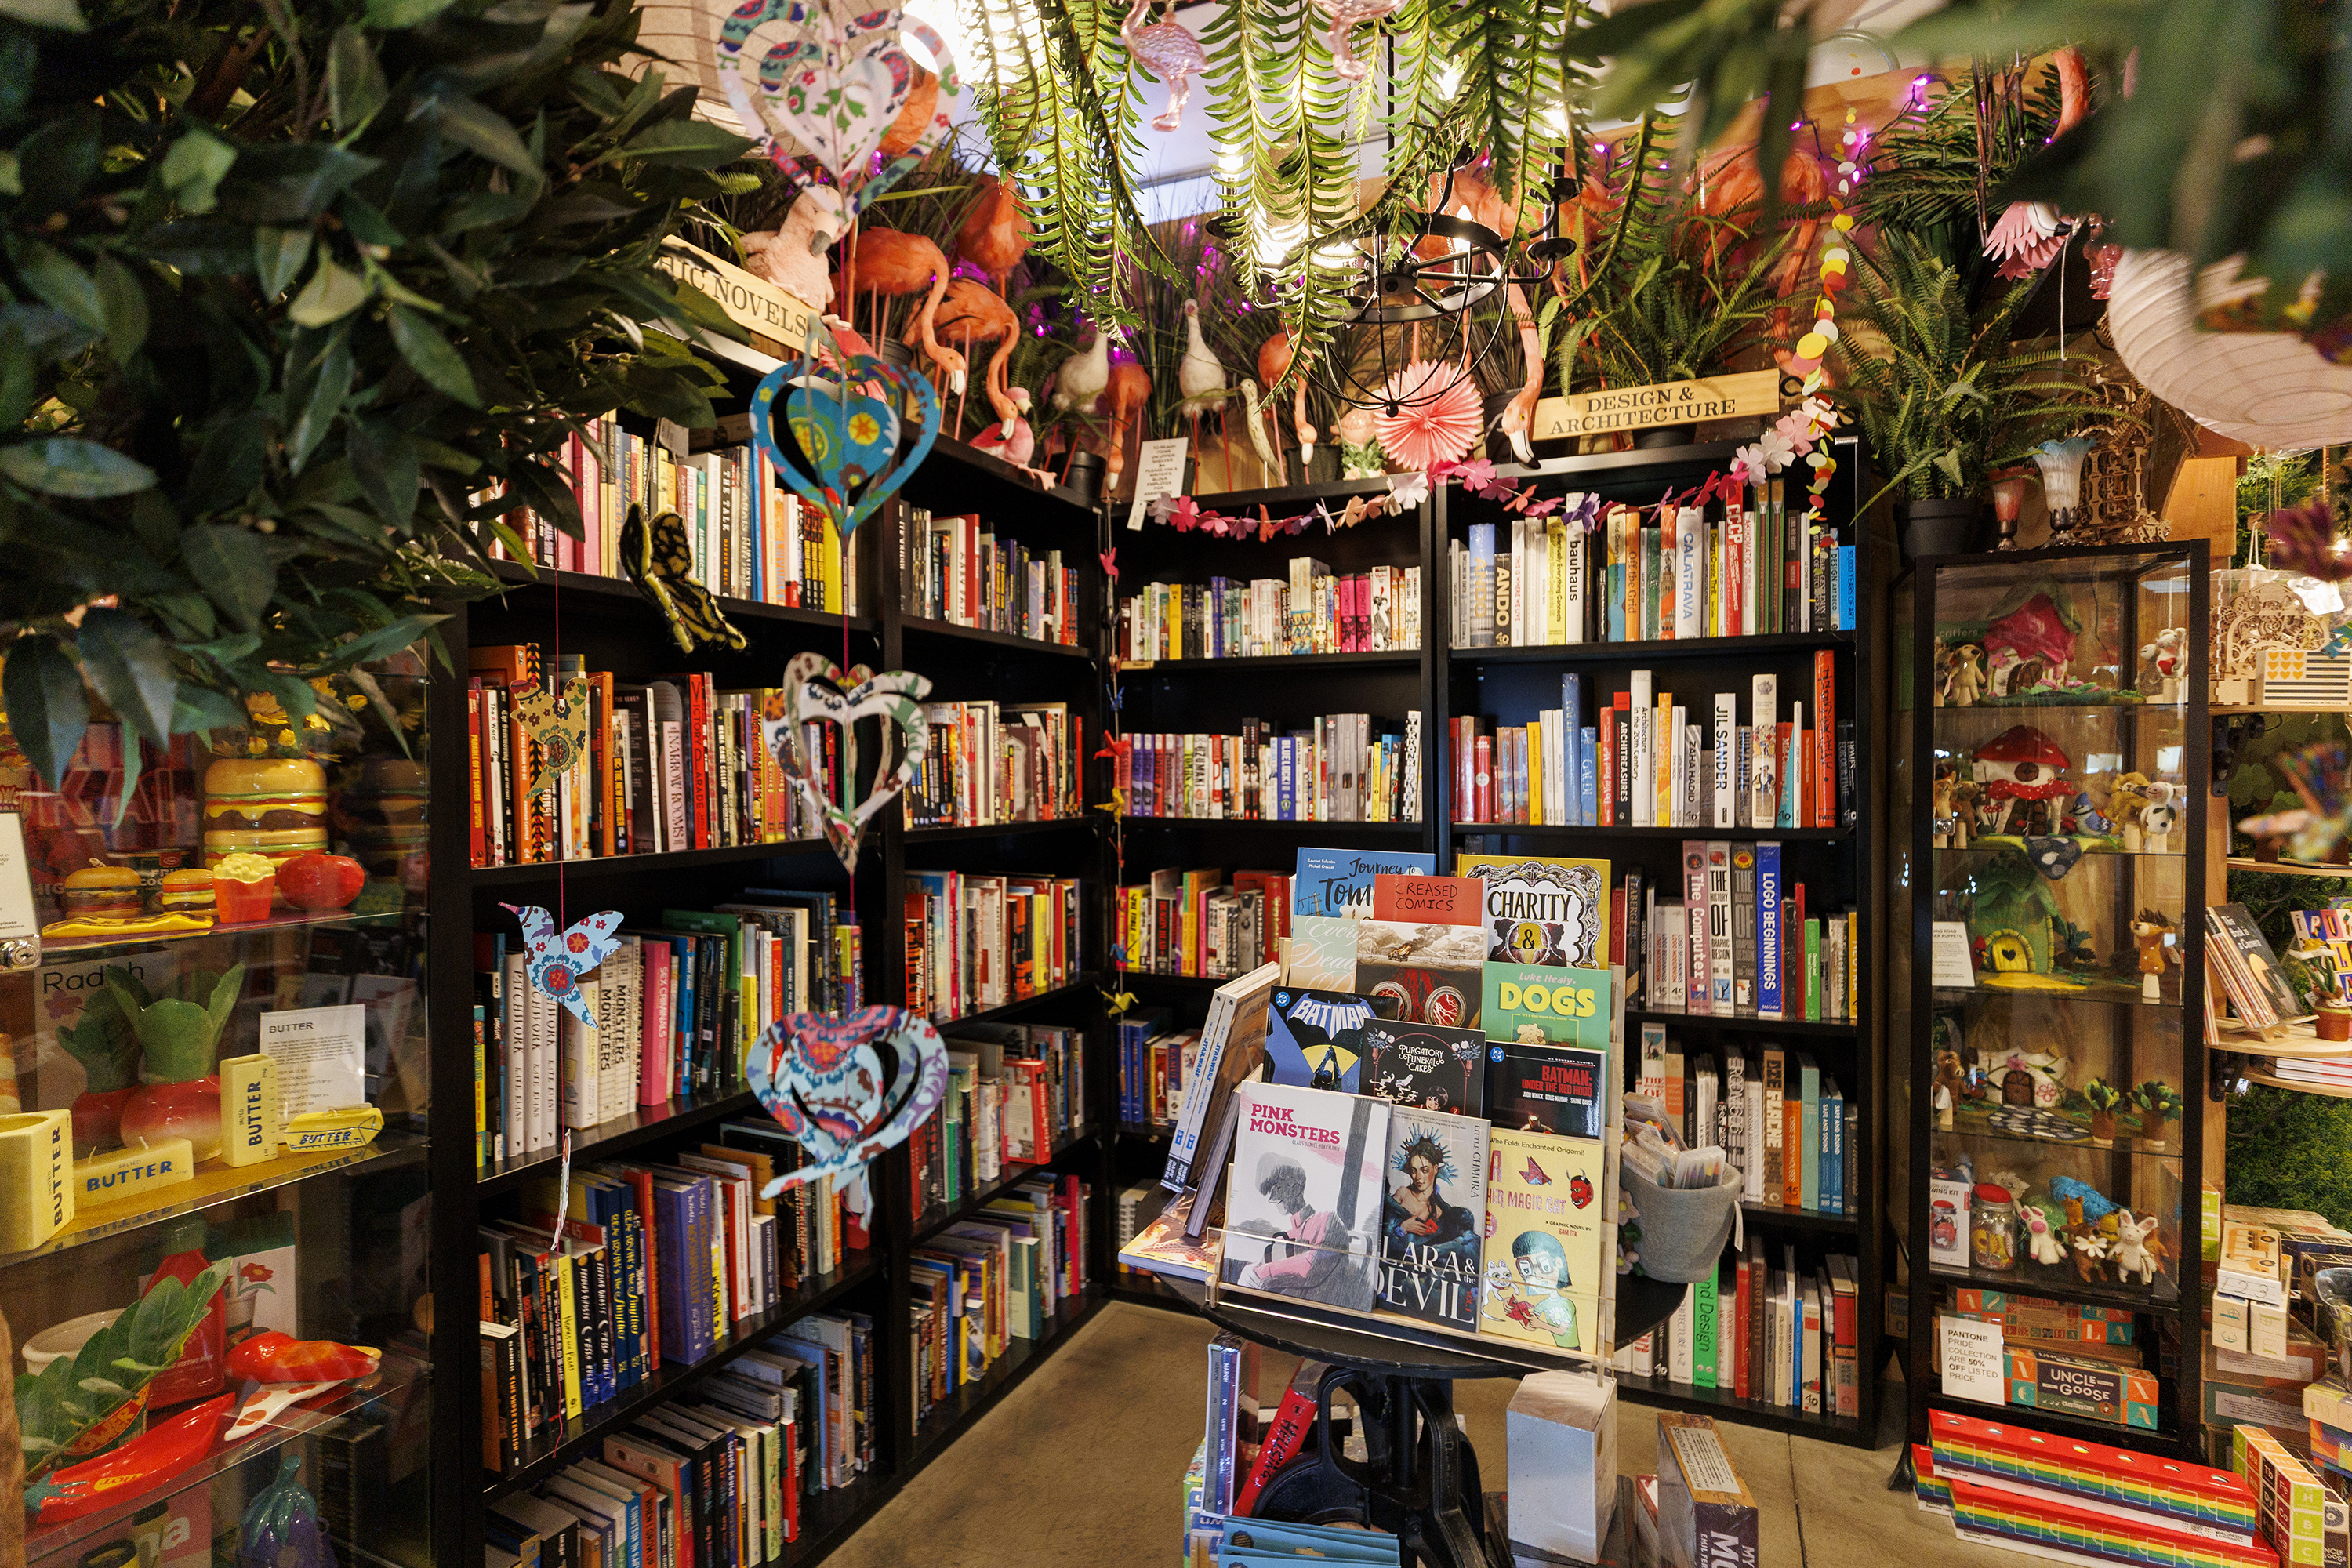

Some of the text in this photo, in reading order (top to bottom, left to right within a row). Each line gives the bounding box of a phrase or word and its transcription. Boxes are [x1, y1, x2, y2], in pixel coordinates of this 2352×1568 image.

[713, 274, 807, 338] NOVELS
[1587, 386, 1694, 412] DESIGN &
[1549, 399, 1736, 435] ARCHITECTURE
[1726, 504, 1743, 543] CCCP
[1570, 540, 1581, 601] bauhaus
[1628, 551, 1638, 613] Off the Grid
[1682, 533, 1694, 619] CALATRAVA
[1475, 557, 1487, 618] ANDO
[1496, 567, 1510, 626] ANDO
[1848, 593, 1854, 603] OF
[1515, 599, 1521, 608] WE
[470, 735, 480, 760] PARABLE
[1715, 706, 1728, 789] JIL SANDER
[1195, 746, 1206, 787] UZUMAKI
[1632, 749, 1640, 780] Century
[1738, 731, 1750, 791] HUMANIZE
[1780, 737, 1789, 786] Mid-Century
[668, 735, 684, 837] NARROW ROOMS
[1688, 771, 1697, 803] HADID
[1349, 856, 1416, 878] Journey to
[1319, 877, 1374, 912] Tom
[1396, 883, 1457, 898] CREASED
[1396, 899, 1454, 912] COMICS
[1487, 890, 1573, 922] CHARITY
[1690, 873, 1706, 979] The Computer
[1762, 873, 1776, 990] LOGO BEGINNINGS
[1522, 929, 1534, 950] &
[1519, 972, 1573, 986] Luke Healy
[512, 970, 524, 1054] PATCHWORK
[658, 967, 667, 1038] SEX CRIMINALS
[1500, 982, 1596, 1018] DOGS
[269, 1022, 314, 1033] BUTTER
[600, 989, 612, 1071] MONSTERS
[615, 985, 626, 1064] MONSTERS
[1294, 1000, 1371, 1040] BATMAN
[1207, 1042, 1221, 1082] STAR WARS
[1399, 1044, 1444, 1060] PURGATORY
[1399, 1051, 1444, 1065] FUNERAL
[1193, 1058, 1204, 1077] WARS
[1407, 1062, 1433, 1073] CAKES
[1542, 1065, 1592, 1087] BATMAN:
[1522, 1079, 1592, 1097] UNDER THE RED HOOD
[248, 1080, 263, 1146] BUTTER
[1250, 1103, 1294, 1122] PINK
[299, 1131, 352, 1145] BUTTER
[1249, 1117, 1341, 1145] MONSTERS
[1504, 1138, 1520, 1148] Folds
[1522, 1142, 1555, 1152] Enchanted
[1556, 1146, 1585, 1156] Origami!
[53, 1125, 63, 1227] BUTTER
[86, 1160, 173, 1192] BUTTER
[1471, 1152, 1482, 1199] CHMURA
[1507, 1191, 1566, 1216] MAGIC CAT
[1380, 1235, 1475, 1283] LARA &
[1463, 1274, 1476, 1284] the
[1696, 1303, 1715, 1352] Design
[1947, 1330, 1988, 1343] PANTONE
[1948, 1338, 1974, 1348] PRIDE
[1948, 1347, 1998, 1361] COLLECTION
[1948, 1356, 1986, 1367] ARE 50%
[1949, 1363, 1998, 1379] OFF LISTED
[1949, 1372, 1975, 1383] PRICE
[2051, 1368, 2096, 1387] UNCLE
[2060, 1383, 2110, 1401] GOOSE
[2279, 1479, 2288, 1495] Fe
[2304, 1494, 2313, 1502] H
[2278, 1507, 2288, 1522] Co
[2303, 1520, 2312, 1529] B
[1740, 1545, 1755, 1563] MY
[2302, 1548, 2312, 1556] C
